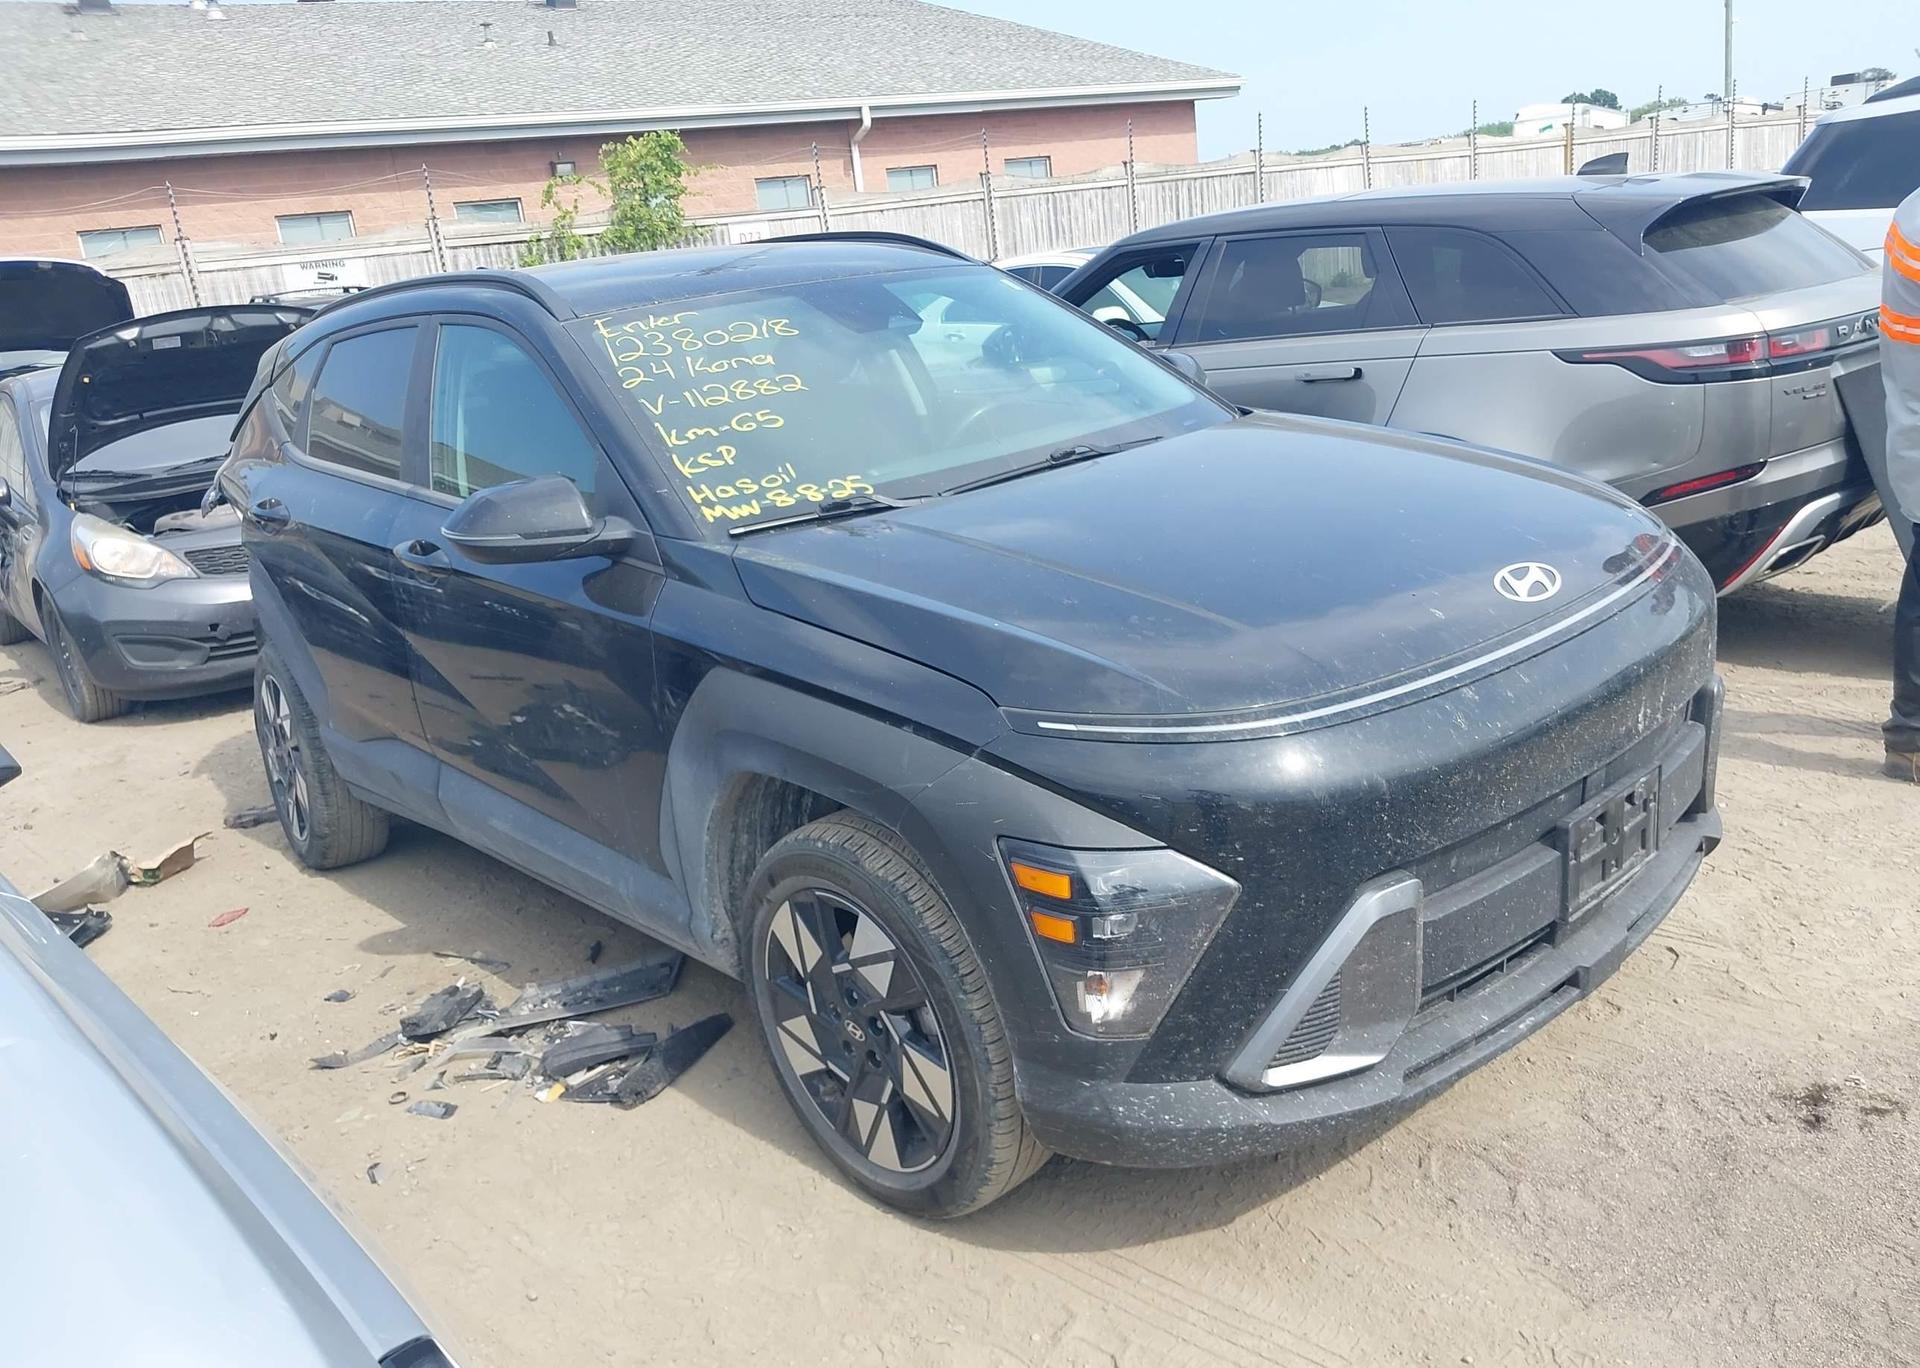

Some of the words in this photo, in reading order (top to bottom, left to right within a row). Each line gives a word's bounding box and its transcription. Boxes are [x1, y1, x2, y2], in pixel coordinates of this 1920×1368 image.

[299, 260, 345, 270] WARNING
[604, 318, 800, 367] 12380218
[1836, 315, 1881, 338] RAN
[616, 360, 677, 389] 24
[685, 354, 776, 378] Kona
[638, 374, 810, 416] V-112882
